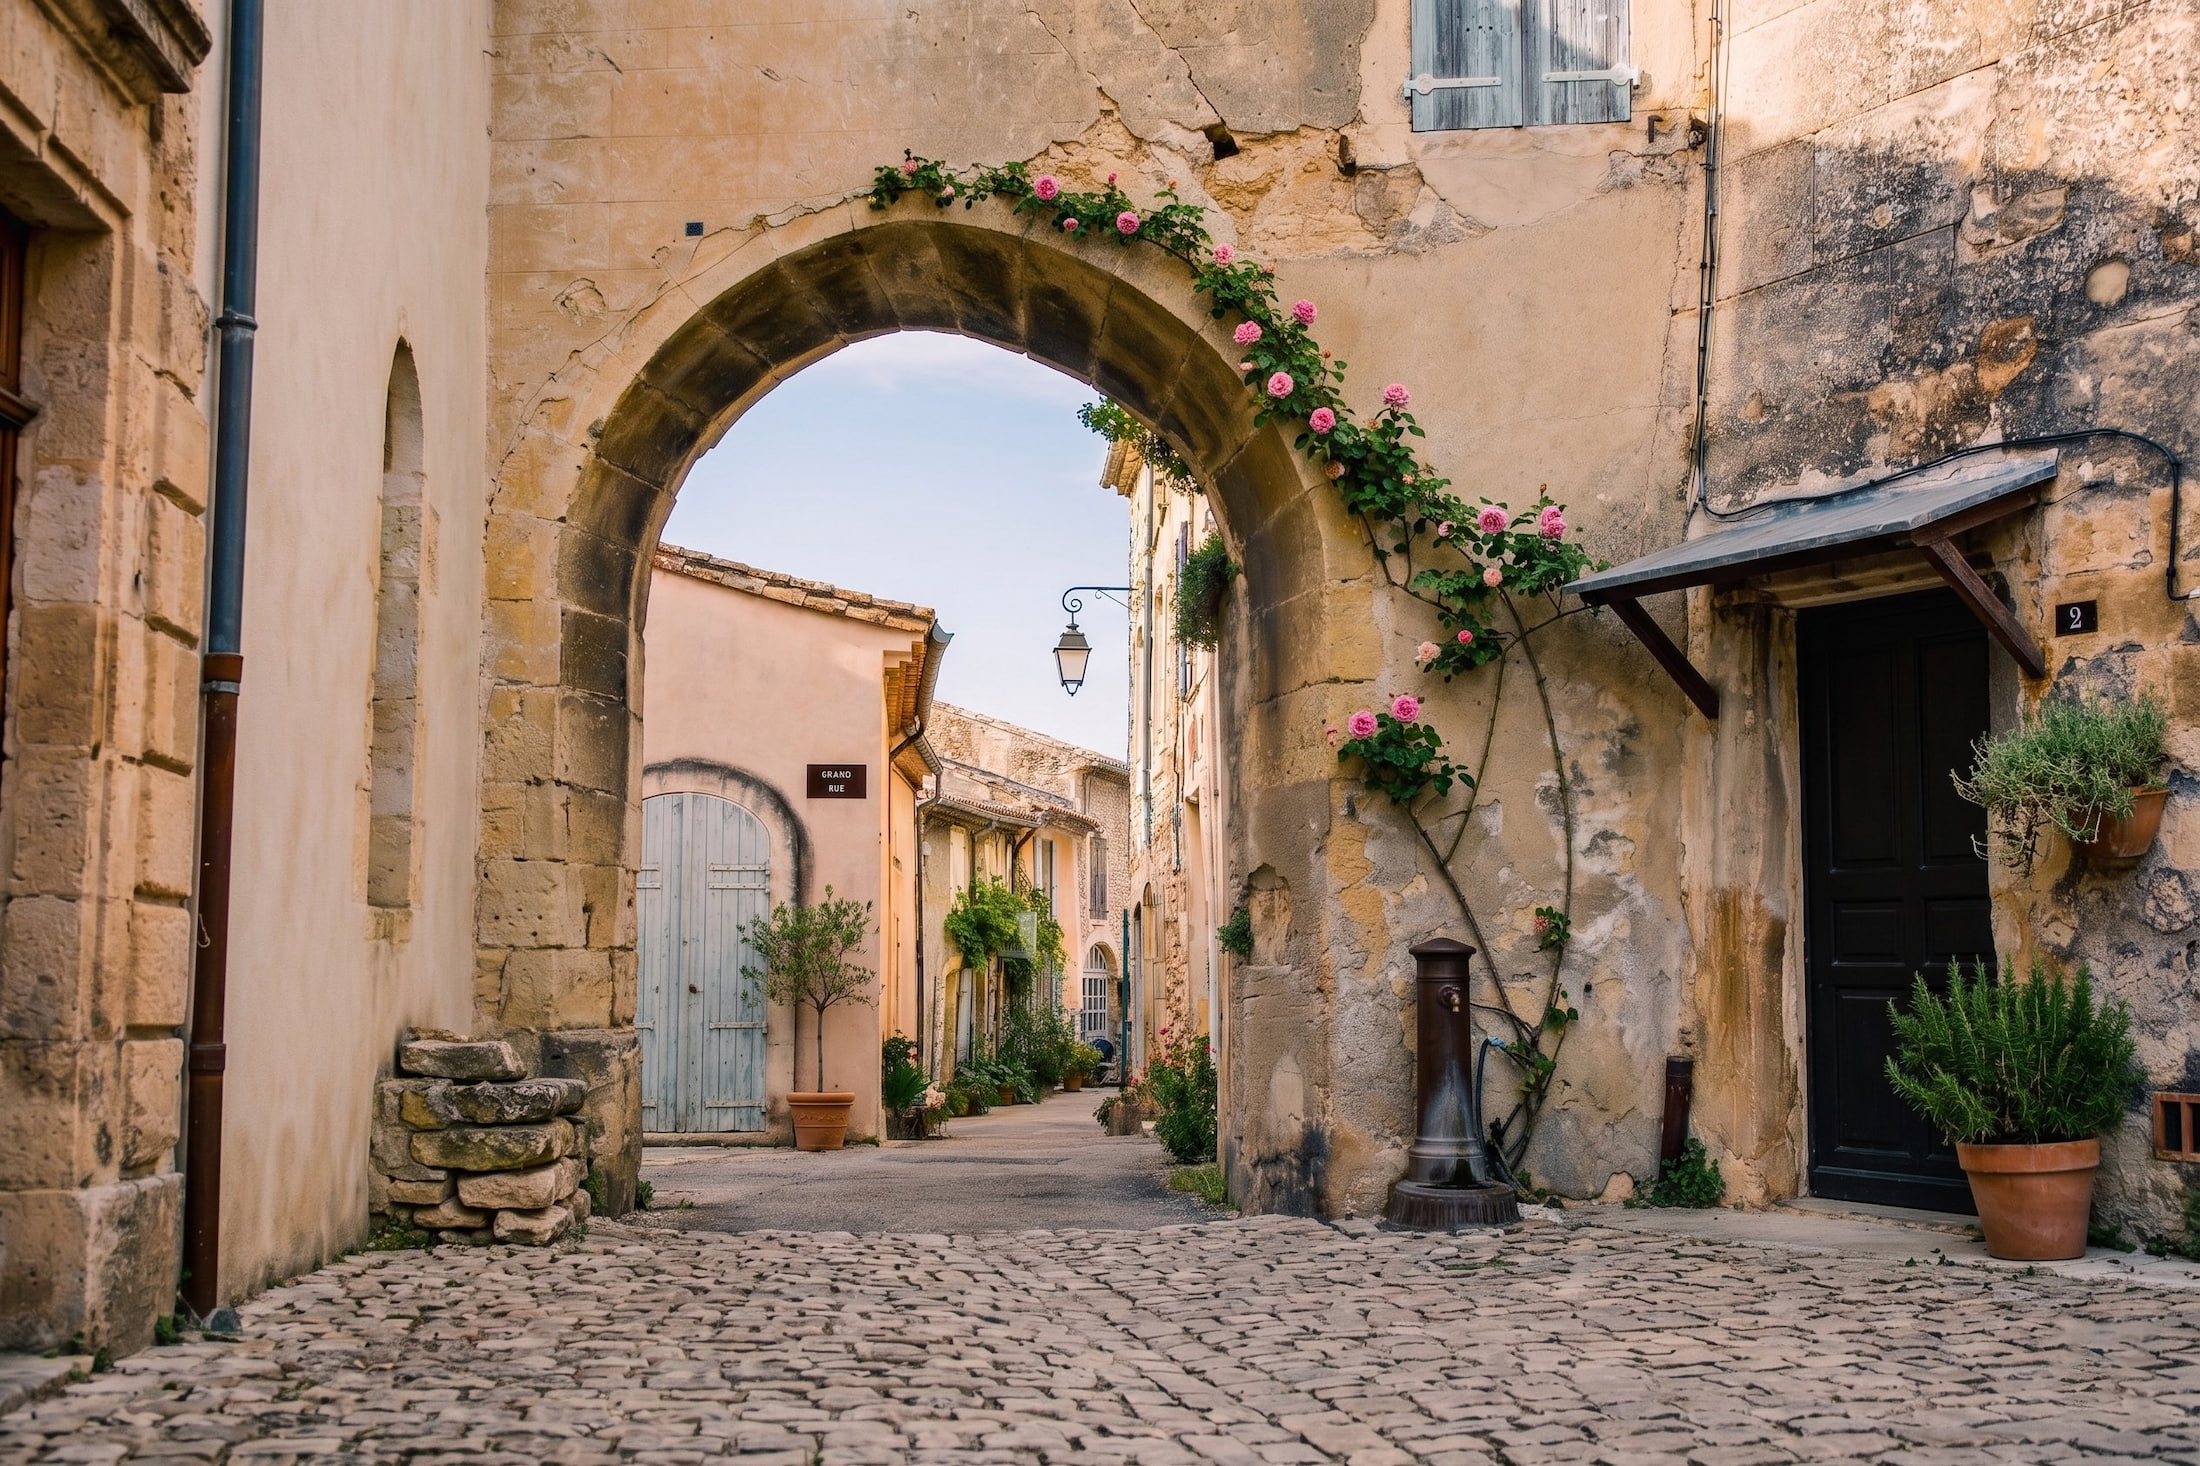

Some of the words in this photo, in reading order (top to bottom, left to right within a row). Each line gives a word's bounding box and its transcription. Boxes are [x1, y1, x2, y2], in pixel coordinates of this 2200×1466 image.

[2069, 606, 2082, 629] 2
[821, 770, 852, 779] GRAND
[828, 784, 845, 793] RUE
